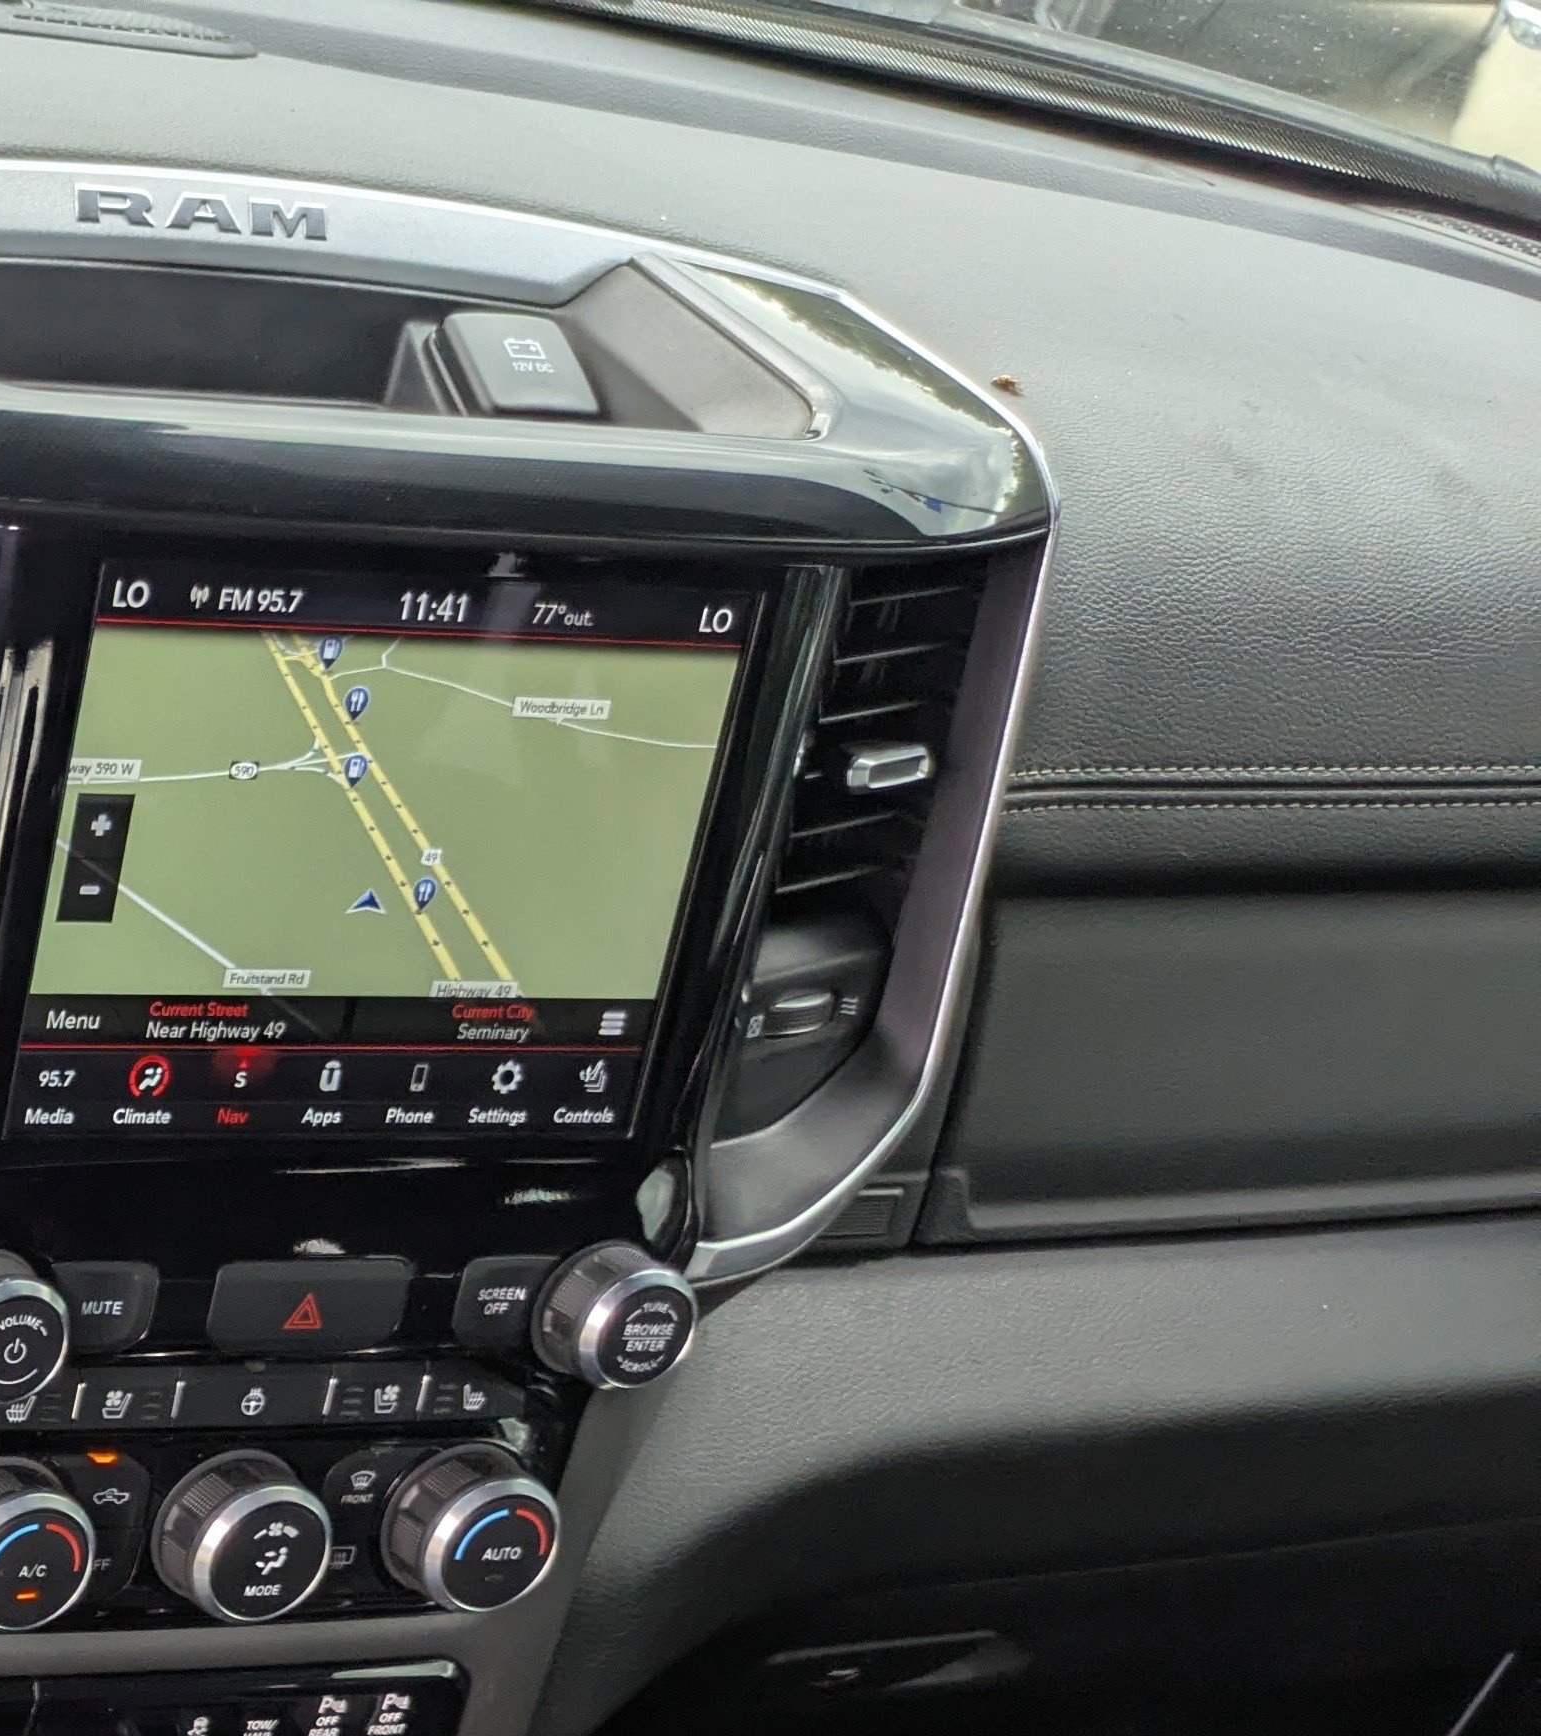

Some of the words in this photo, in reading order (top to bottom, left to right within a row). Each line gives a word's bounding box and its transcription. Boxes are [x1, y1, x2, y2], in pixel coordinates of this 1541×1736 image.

[75, 183, 327, 241] RAM
[111, 579, 151, 609] LO
[218, 589, 253, 612] FM
[257, 589, 305, 613] 95.7
[399, 591, 470, 623] 11:41
[698, 606, 734, 634] LO
[519, 700, 587, 717] Woodbridge
[589, 704, 604, 716] Ln
[95, 762, 118, 776] 590
[121, 763, 135, 775] W
[232, 764, 255, 777] 590
[229, 973, 286, 985] Fruitstand
[287, 973, 306, 985] Rd
[149, 1001, 205, 1018] Current
[207, 1002, 250, 1018] Street
[451, 1003, 504, 1019] Current
[506, 1003, 535, 1021] City
[46, 1010, 101, 1031] Menu
[146, 1022, 188, 1040] Near
[190, 1022, 261, 1043] Highway
[263, 1022, 286, 1039] 49
[457, 1023, 530, 1043] Seminary
[38, 1070, 76, 1088] 95.7
[234, 1071, 247, 1088] S
[24, 1108, 75, 1125] Media
[112, 1108, 172, 1125] Climate
[217, 1108, 249, 1124] Nav
[301, 1108, 342, 1126] Apps
[385, 1108, 434, 1125] Phone
[468, 1108, 526, 1126] Settings
[553, 1108, 615, 1125] Controls
[477, 1287, 527, 1301] SCREEN
[81, 1301, 124, 1316] MUTE
[484, 1302, 509, 1316] OFF
[623, 1323, 675, 1336] BROWSE
[625, 1340, 667, 1352] ENTER
[481, 1547, 522, 1561] AUTO
[18, 1564, 48, 1579] A/C
[93, 1558, 111, 1571] FF
[243, 1584, 281, 1598] MODE
[315, 1715, 341, 1727] OFF
[378, 1711, 404, 1724] OFF
[367, 1723, 408, 1736] FRONT
